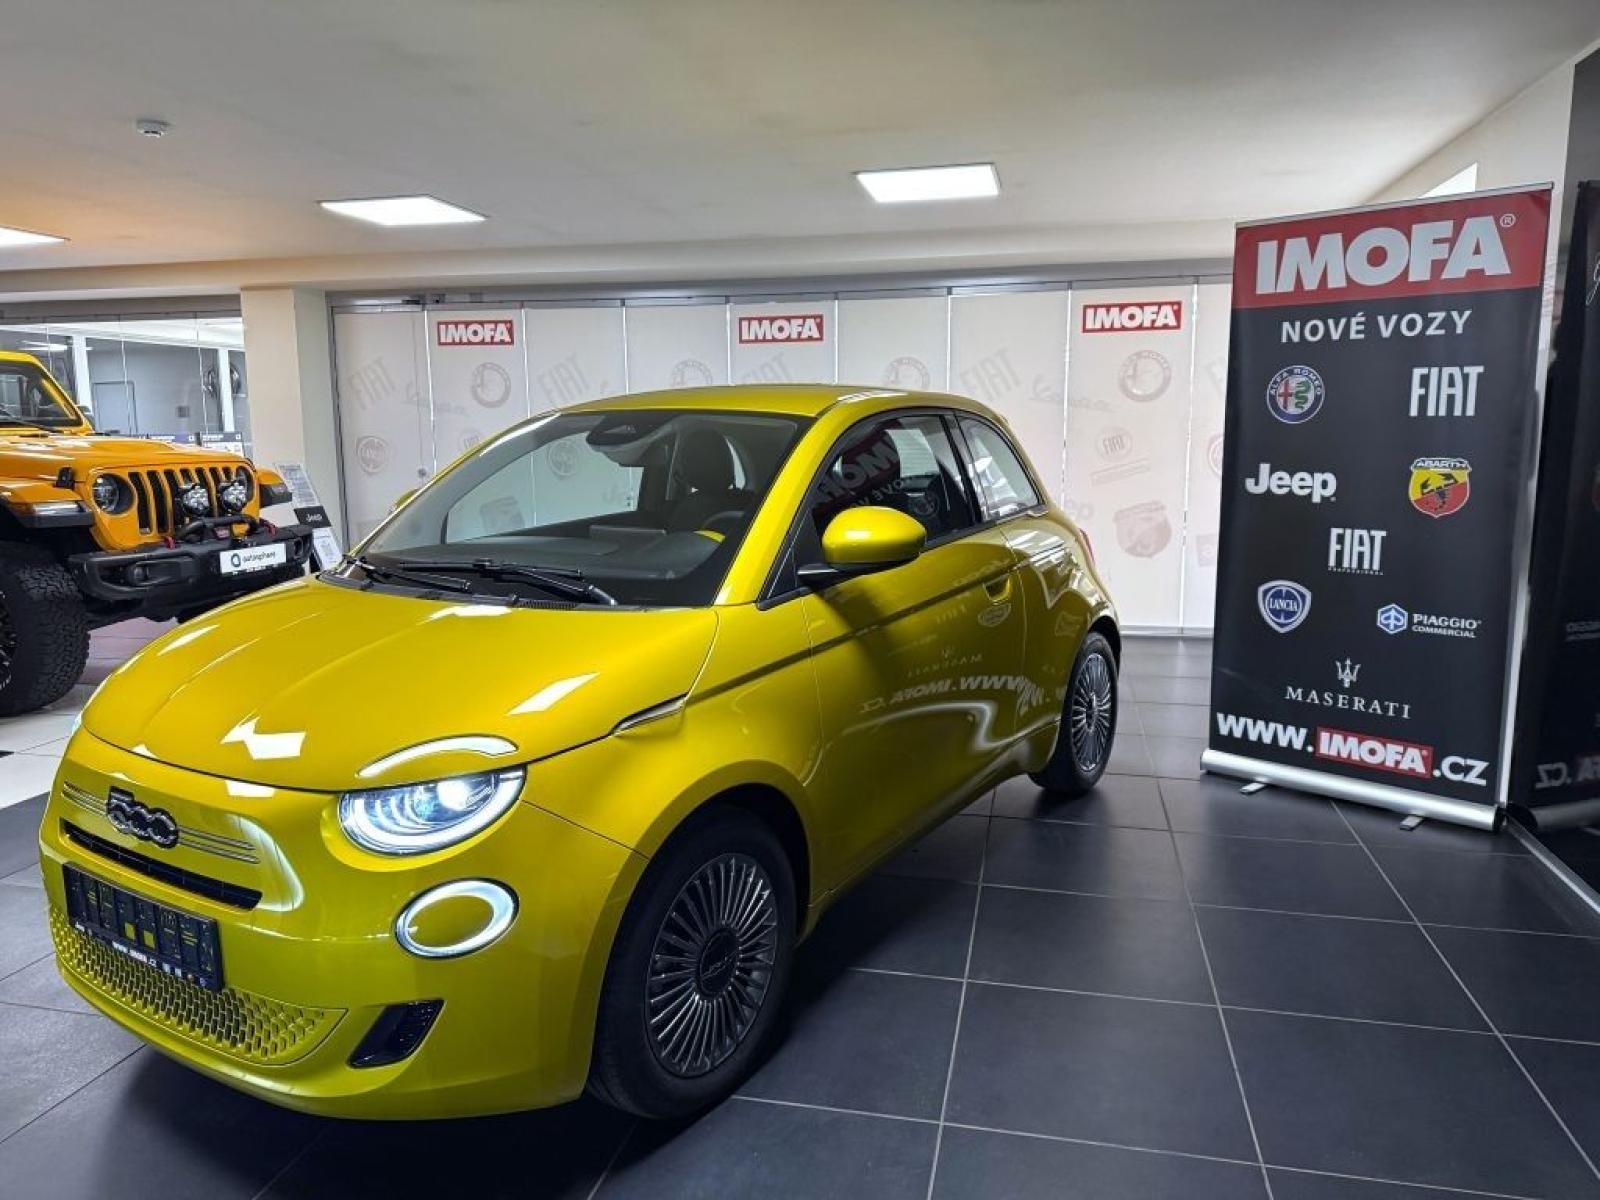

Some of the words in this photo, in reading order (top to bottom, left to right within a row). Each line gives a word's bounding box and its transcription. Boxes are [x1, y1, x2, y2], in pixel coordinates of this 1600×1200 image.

[1085, 304, 1178, 329] IMOFA
[1281, 312, 1366, 343] NOVÉ
[1377, 310, 1472, 338] VOZY
[440, 322, 512, 343] IMOFA
[742, 318, 820, 341] IMOFA
[1409, 365, 1484, 417] FIAT
[1245, 463, 1337, 504] Jeep
[1328, 527, 1387, 572] FIAT
[1269, 598, 1298, 612] LANCIA
[1411, 625, 1476, 638] COMMERCIAL
[1412, 613, 1478, 630] PIAGGIO
[1285, 686, 1412, 719] MASERATI
